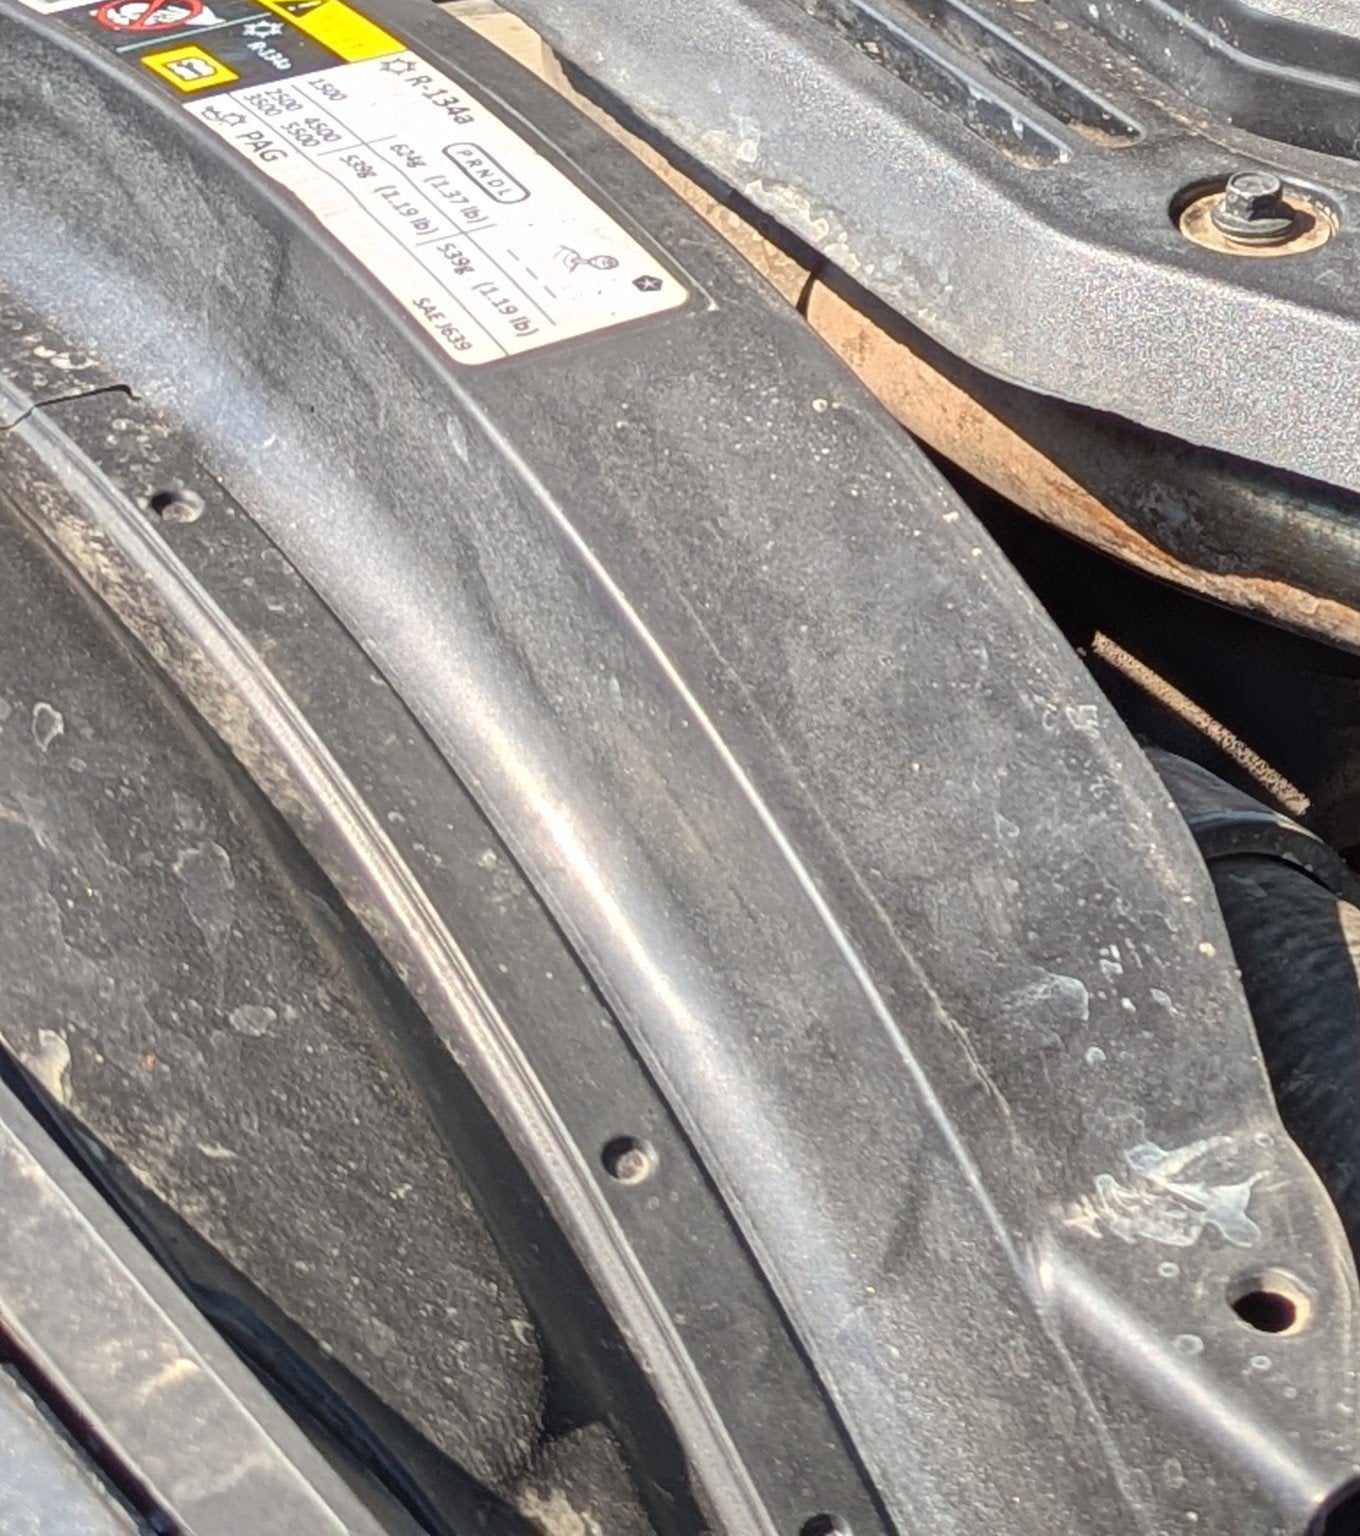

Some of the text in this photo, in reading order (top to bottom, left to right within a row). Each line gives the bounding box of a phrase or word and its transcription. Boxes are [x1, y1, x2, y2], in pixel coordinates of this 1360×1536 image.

[264, 88, 342, 143] 2500 4500
[307, 78, 348, 102] 1500
[406, 75, 475, 125] R-134a
[236, 129, 289, 163] PAG
[244, 94, 321, 147] 3500 5500
[373, 184, 420, 218] (1.19
[410, 215, 439, 236] lb)
[423, 175, 470, 205] (1.37
[460, 202, 489, 224] lb)
[437, 243, 540, 338] 539g (1.19 lb)
[412, 296, 473, 351] SAE J639
